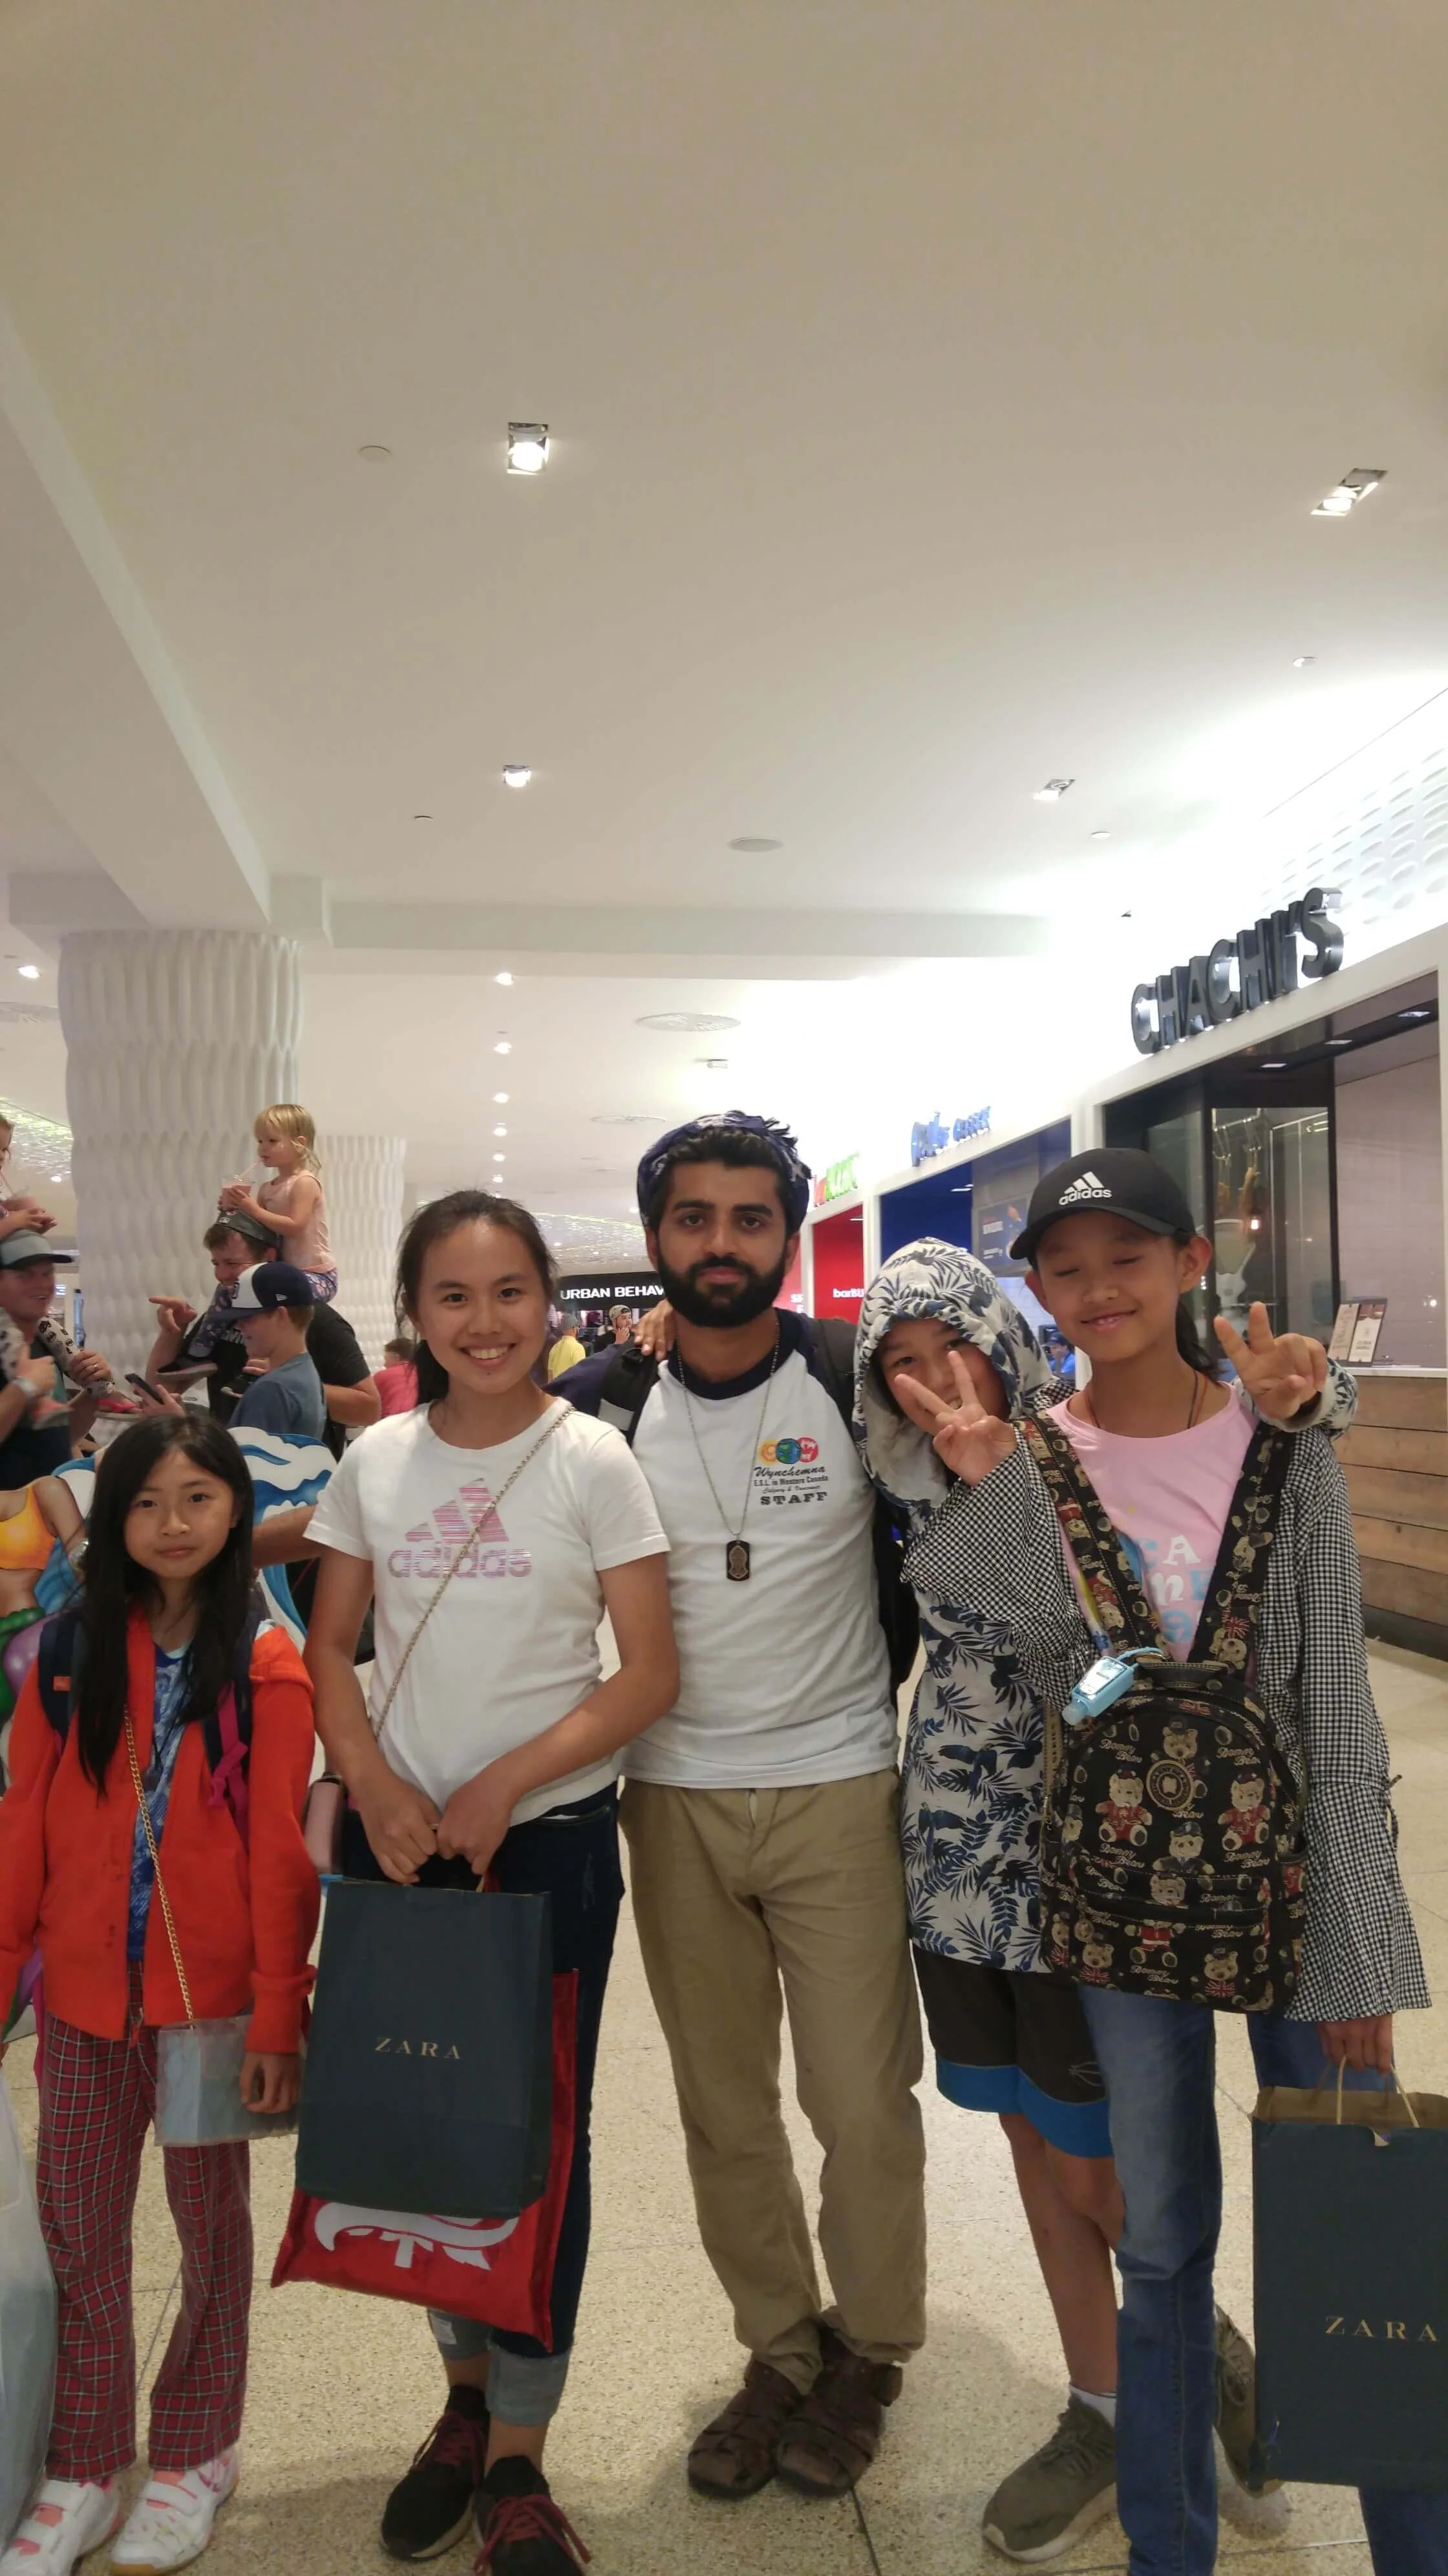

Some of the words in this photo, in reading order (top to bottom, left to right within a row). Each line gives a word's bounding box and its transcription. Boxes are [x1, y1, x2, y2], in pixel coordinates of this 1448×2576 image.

[1059, 1187, 1112, 1206] adidas
[560, 1288, 610, 1299] URBAN
[760, 1492, 828, 1505] STAFF
[388, 1541, 532, 1578] adidas
[374, 2037, 461, 2061] ZARA
[1325, 2316, 1440, 2342] ZARA
